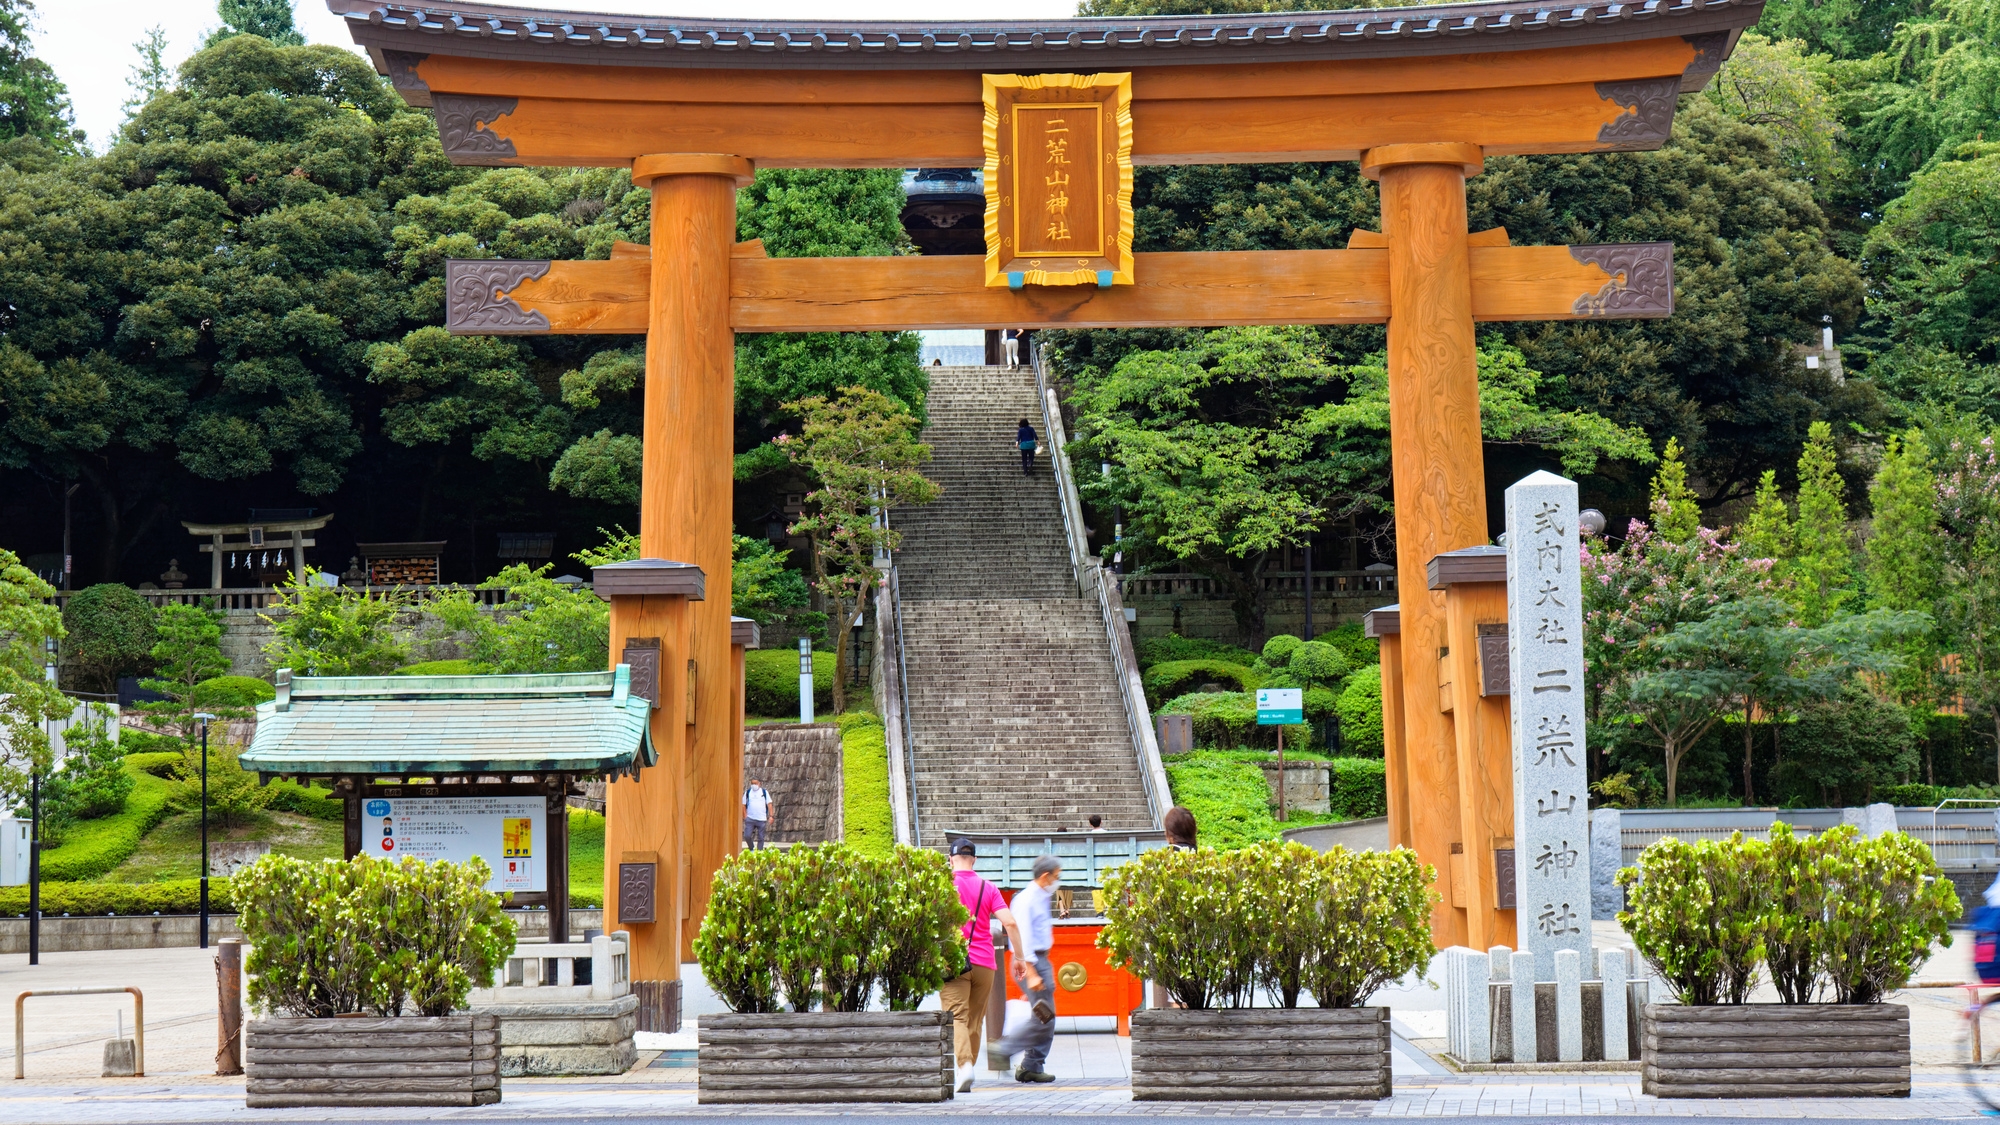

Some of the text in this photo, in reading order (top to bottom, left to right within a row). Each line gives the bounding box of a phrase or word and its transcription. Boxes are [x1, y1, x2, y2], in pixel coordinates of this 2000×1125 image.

[1045, 118, 1071, 240] 二荒山神社
